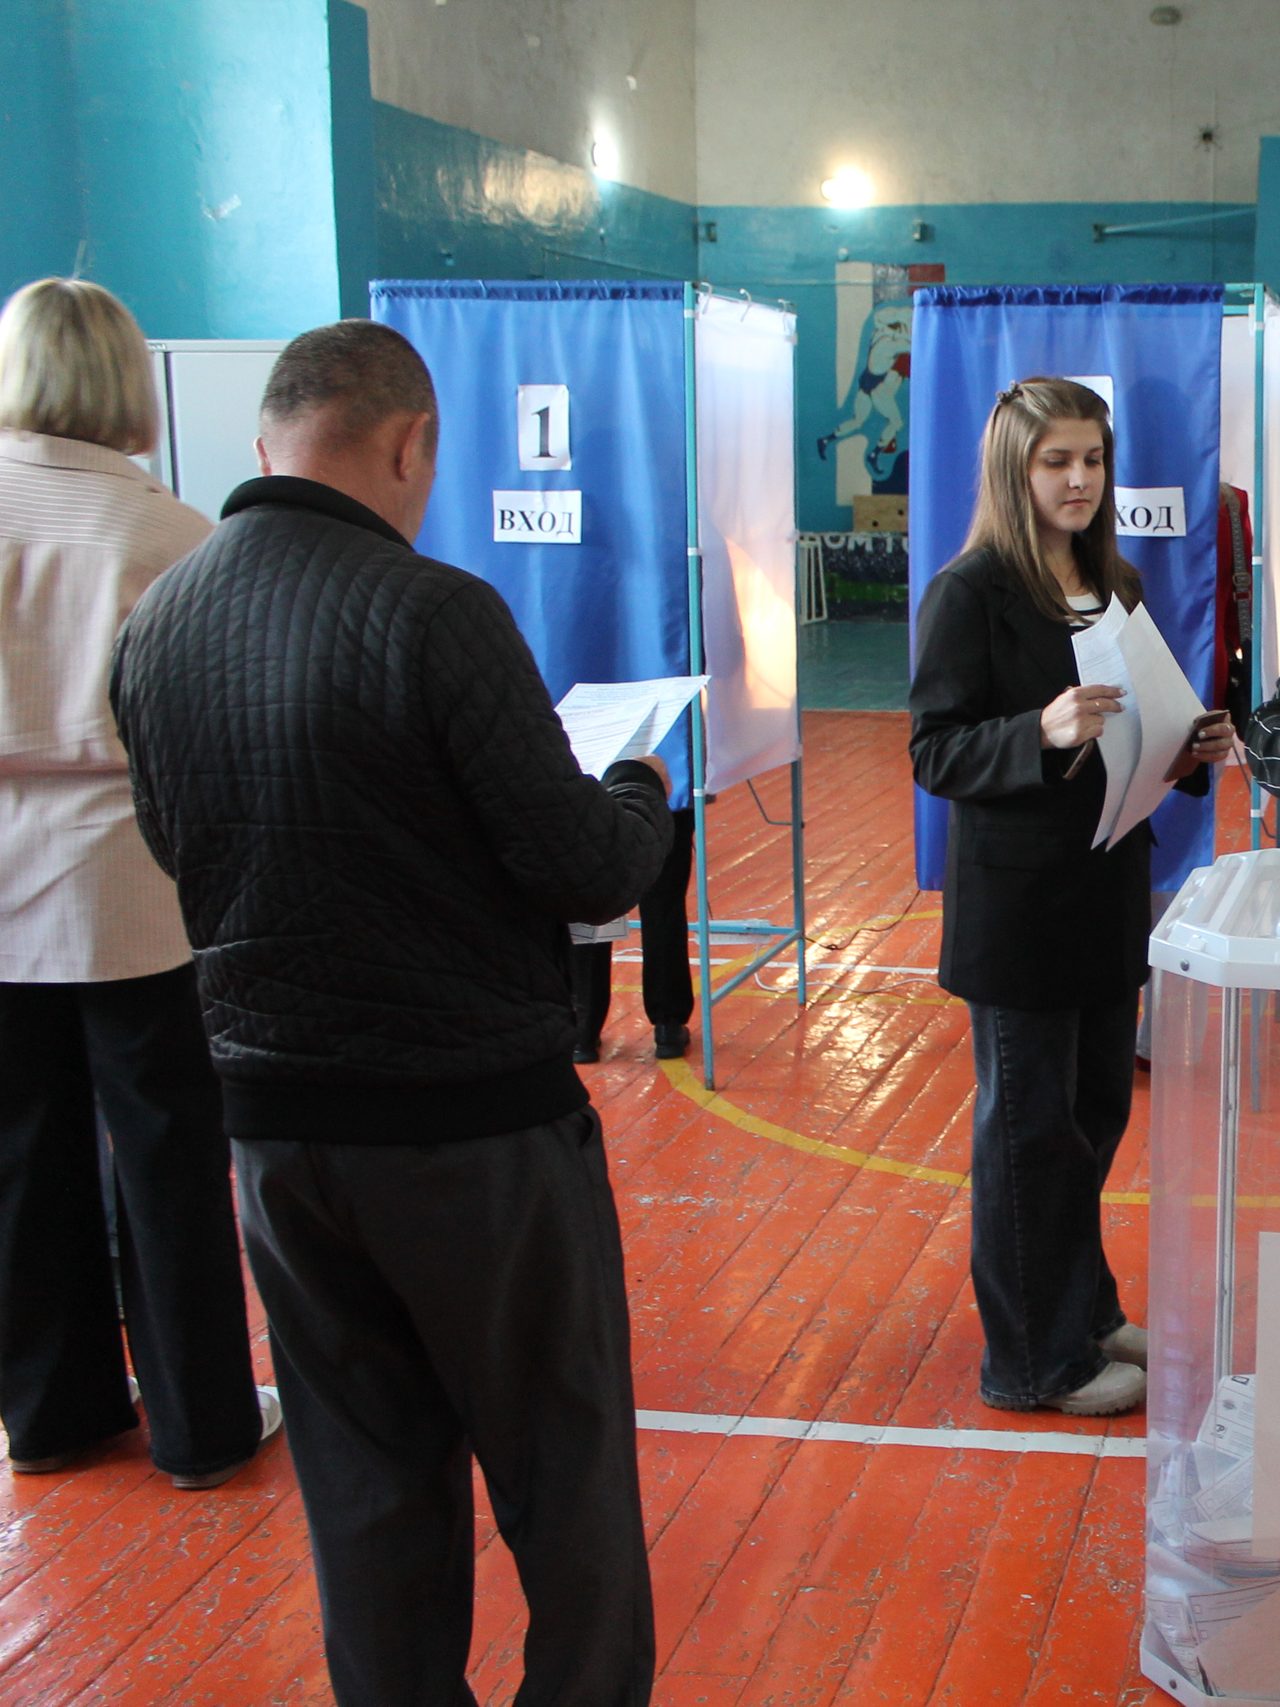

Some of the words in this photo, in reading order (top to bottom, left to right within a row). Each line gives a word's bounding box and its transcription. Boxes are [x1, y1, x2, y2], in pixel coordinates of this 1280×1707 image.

[531, 406, 557, 459] 1
[498, 509, 575, 536] ВХОД
[1115, 506, 1175, 533] ХОД
